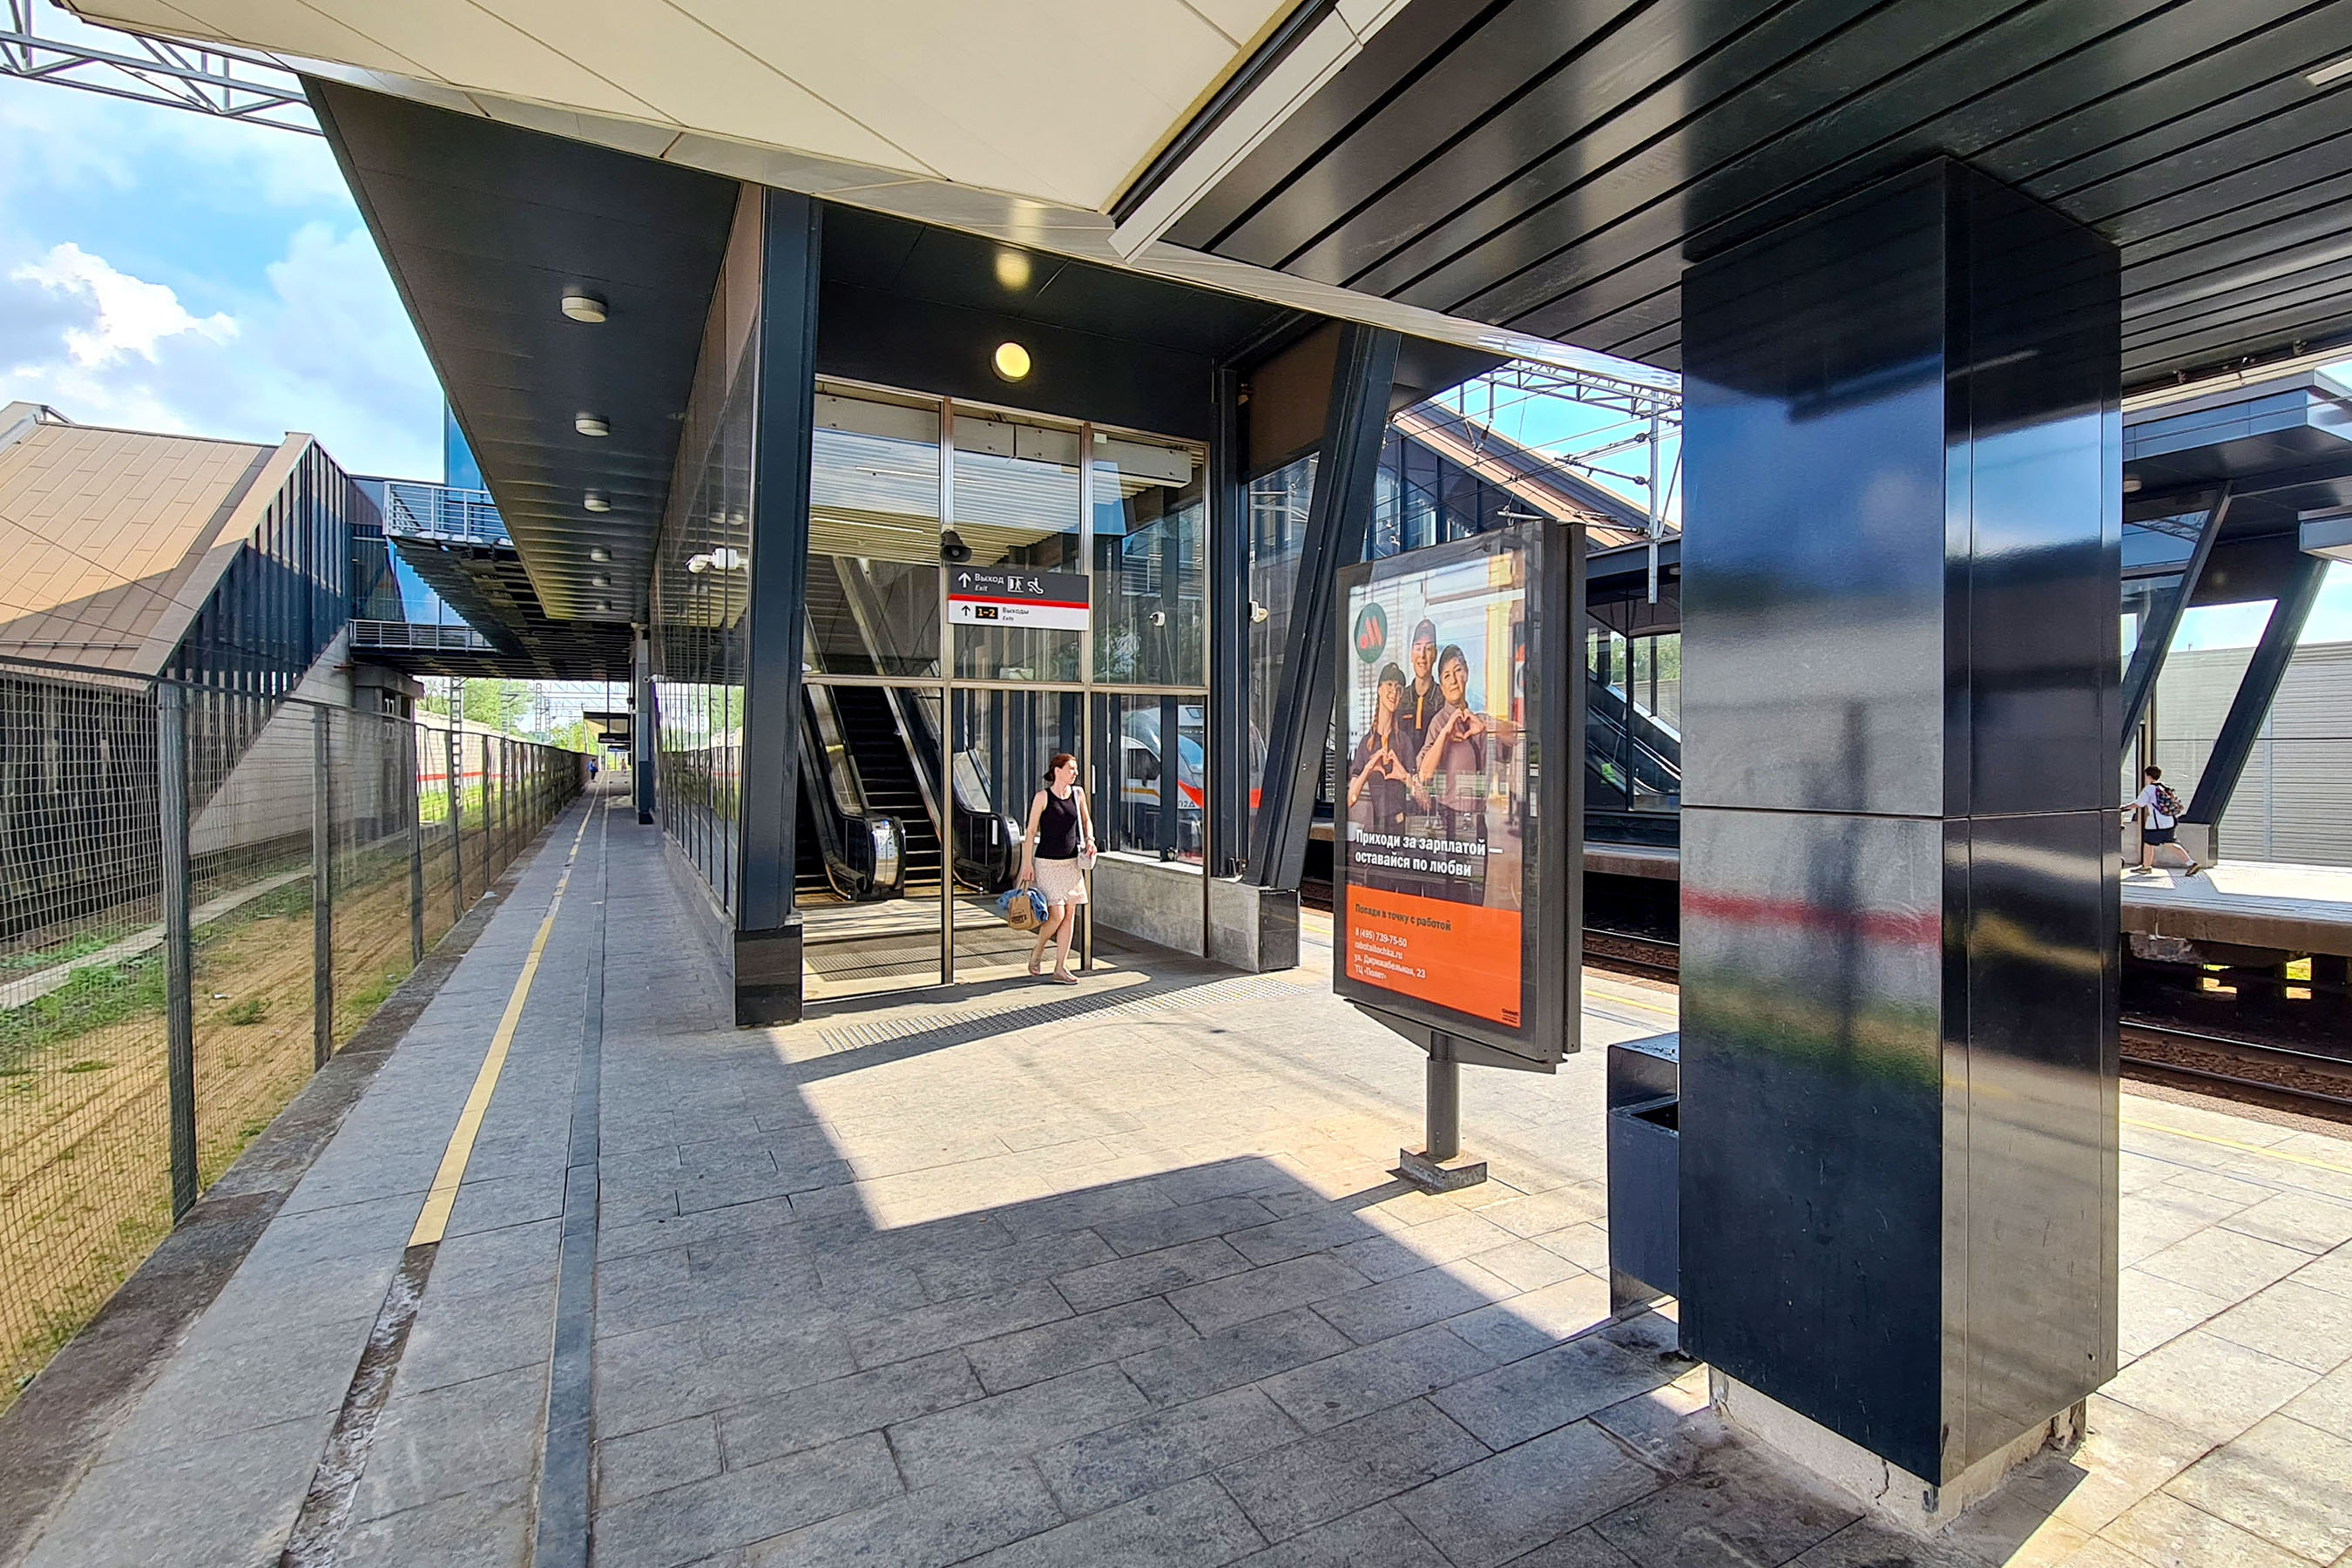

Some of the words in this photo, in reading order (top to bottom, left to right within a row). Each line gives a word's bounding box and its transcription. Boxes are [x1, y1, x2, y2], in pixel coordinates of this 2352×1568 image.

[975, 573, 1004, 585] Выход
[977, 608, 996, 618] 1-2
[1355, 828, 1401, 848] Приходи
[1402, 836, 1416, 849] за
[1418, 839, 1486, 856] зарплатой
[1355, 851, 1410, 870] оставайся
[1412, 858, 1428, 871] по
[1429, 860, 1472, 877] любви
[1355, 903, 1381, 917] Попади
[1388, 912, 1409, 924] точку
[1416, 917, 1451, 931] работой
[1355, 927, 1360, 936] 8
[1360, 928, 1375, 941] (495)
[1375, 932, 1408, 948] 739-75-50
[1416, 968, 1426, 978] 23
